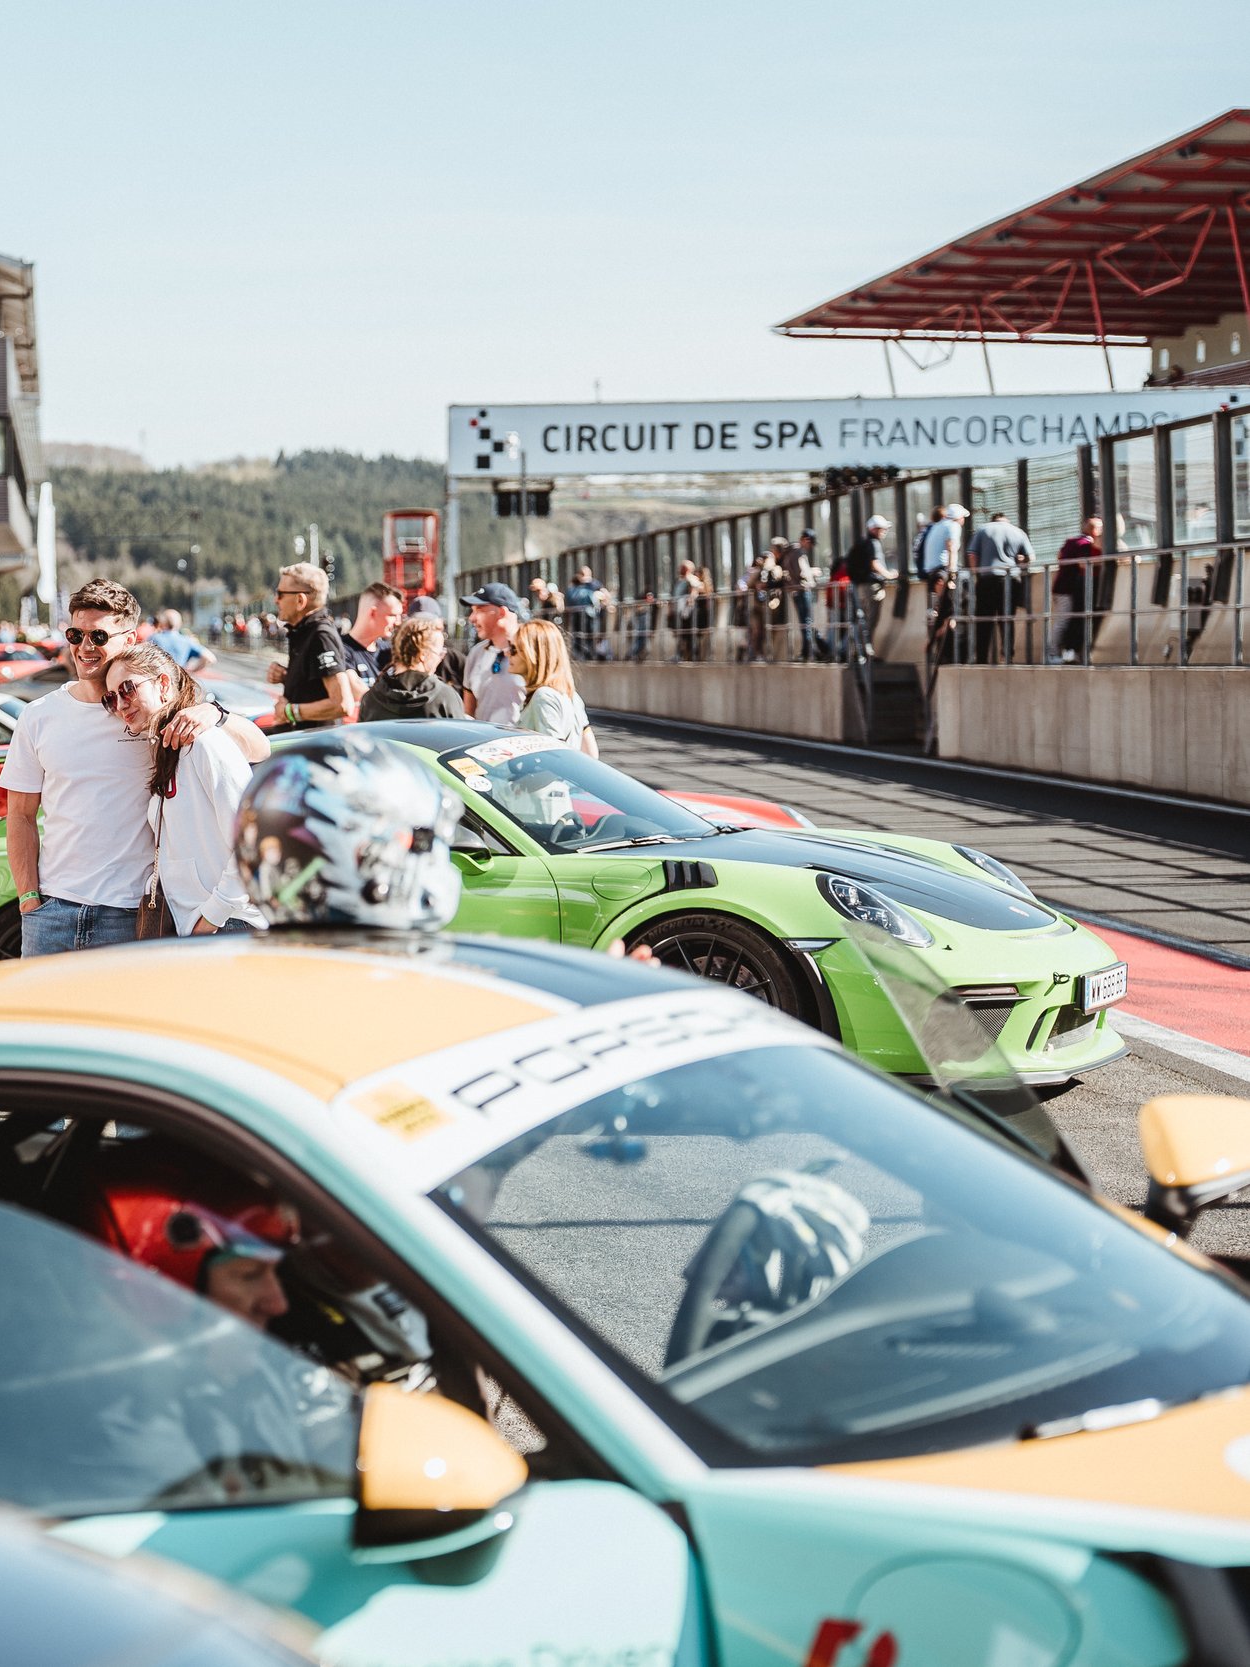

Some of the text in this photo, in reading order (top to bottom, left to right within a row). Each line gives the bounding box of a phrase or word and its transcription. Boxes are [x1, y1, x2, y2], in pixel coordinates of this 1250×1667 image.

[542, 422, 681, 453] CIRCUIT
[693, 421, 739, 450] DE
[753, 420, 823, 450] SPA
[450, 1004, 780, 1114] PORSC
